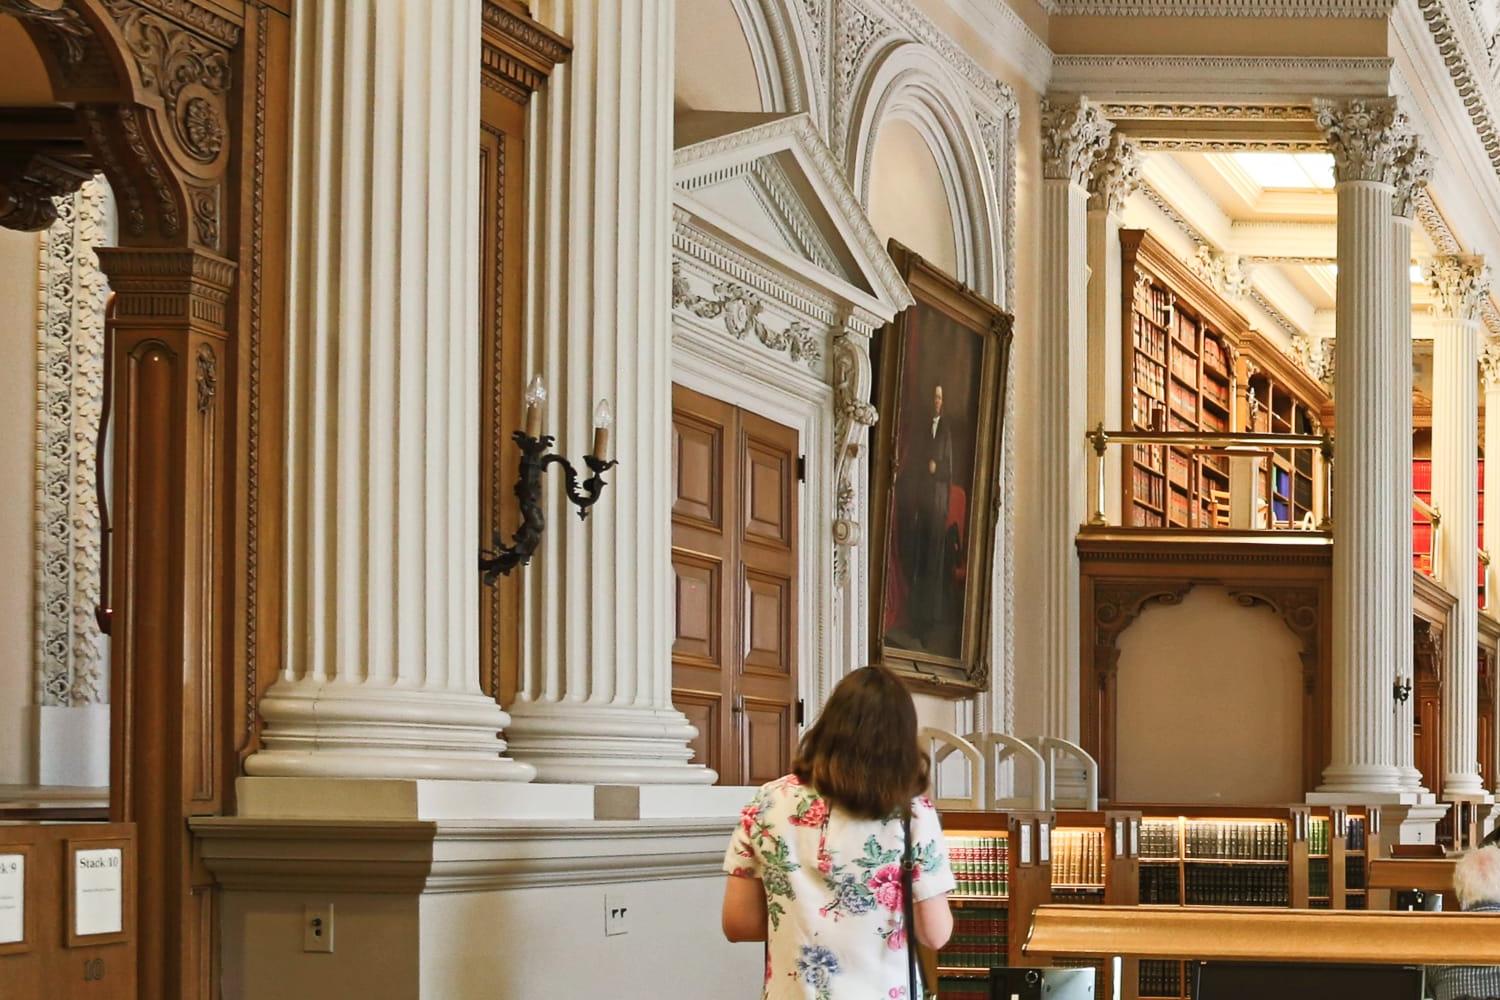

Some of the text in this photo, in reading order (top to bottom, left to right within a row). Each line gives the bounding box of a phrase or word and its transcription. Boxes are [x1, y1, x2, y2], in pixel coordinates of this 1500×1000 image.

[79, 856, 119, 869] Stack 10
[83, 958, 105, 982] 10
